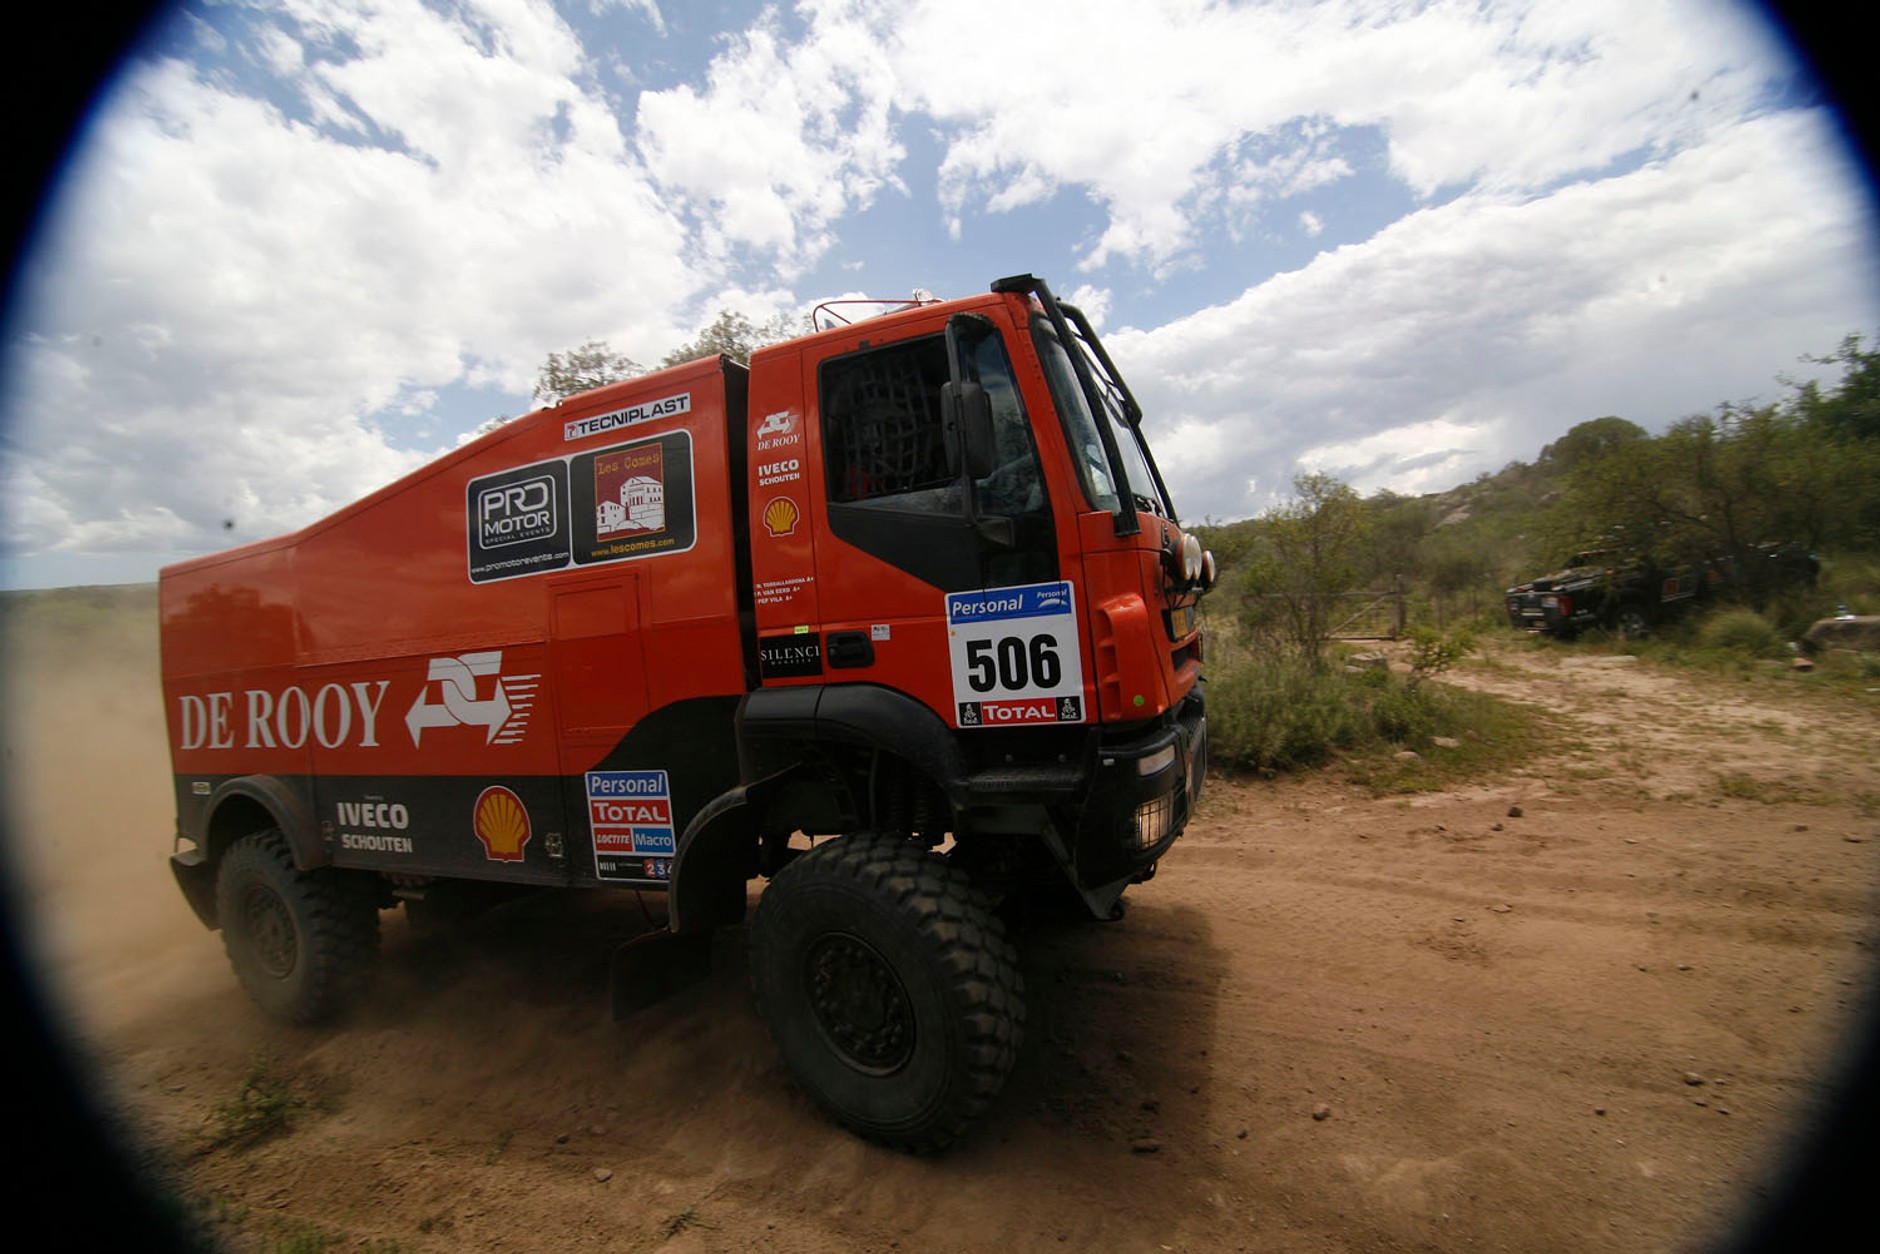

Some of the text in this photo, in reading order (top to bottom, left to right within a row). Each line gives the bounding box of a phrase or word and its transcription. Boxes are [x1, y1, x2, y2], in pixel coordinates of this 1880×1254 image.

[578, 396, 688, 434] TECNIPLAST
[758, 434, 800, 451] DE ROOY
[598, 453, 660, 475] Les Comes
[758, 459, 799, 477] IVECO
[759, 473, 800, 486] SCHOUTEN
[484, 482, 549, 520] PRO
[485, 510, 550, 537] MOTOR
[485, 528, 551, 544] SPECIAL EVENTS
[592, 537, 675, 557] www.lescomes.com
[1036, 588, 1068, 599] Personal
[952, 594, 1023, 616] Personal
[760, 645, 820, 661] SILENCI
[966, 633, 1062, 692] 506
[178, 680, 391, 750] DE ROOY
[983, 705, 1055, 720] TOTAL
[591, 774, 662, 793] Personal
[337, 802, 409, 829] IVECO
[593, 802, 667, 821] TOTAL
[341, 834, 413, 853] SCHOUTEN
[596, 834, 631, 844] LOCTITE
[635, 834, 672, 846] Macro
